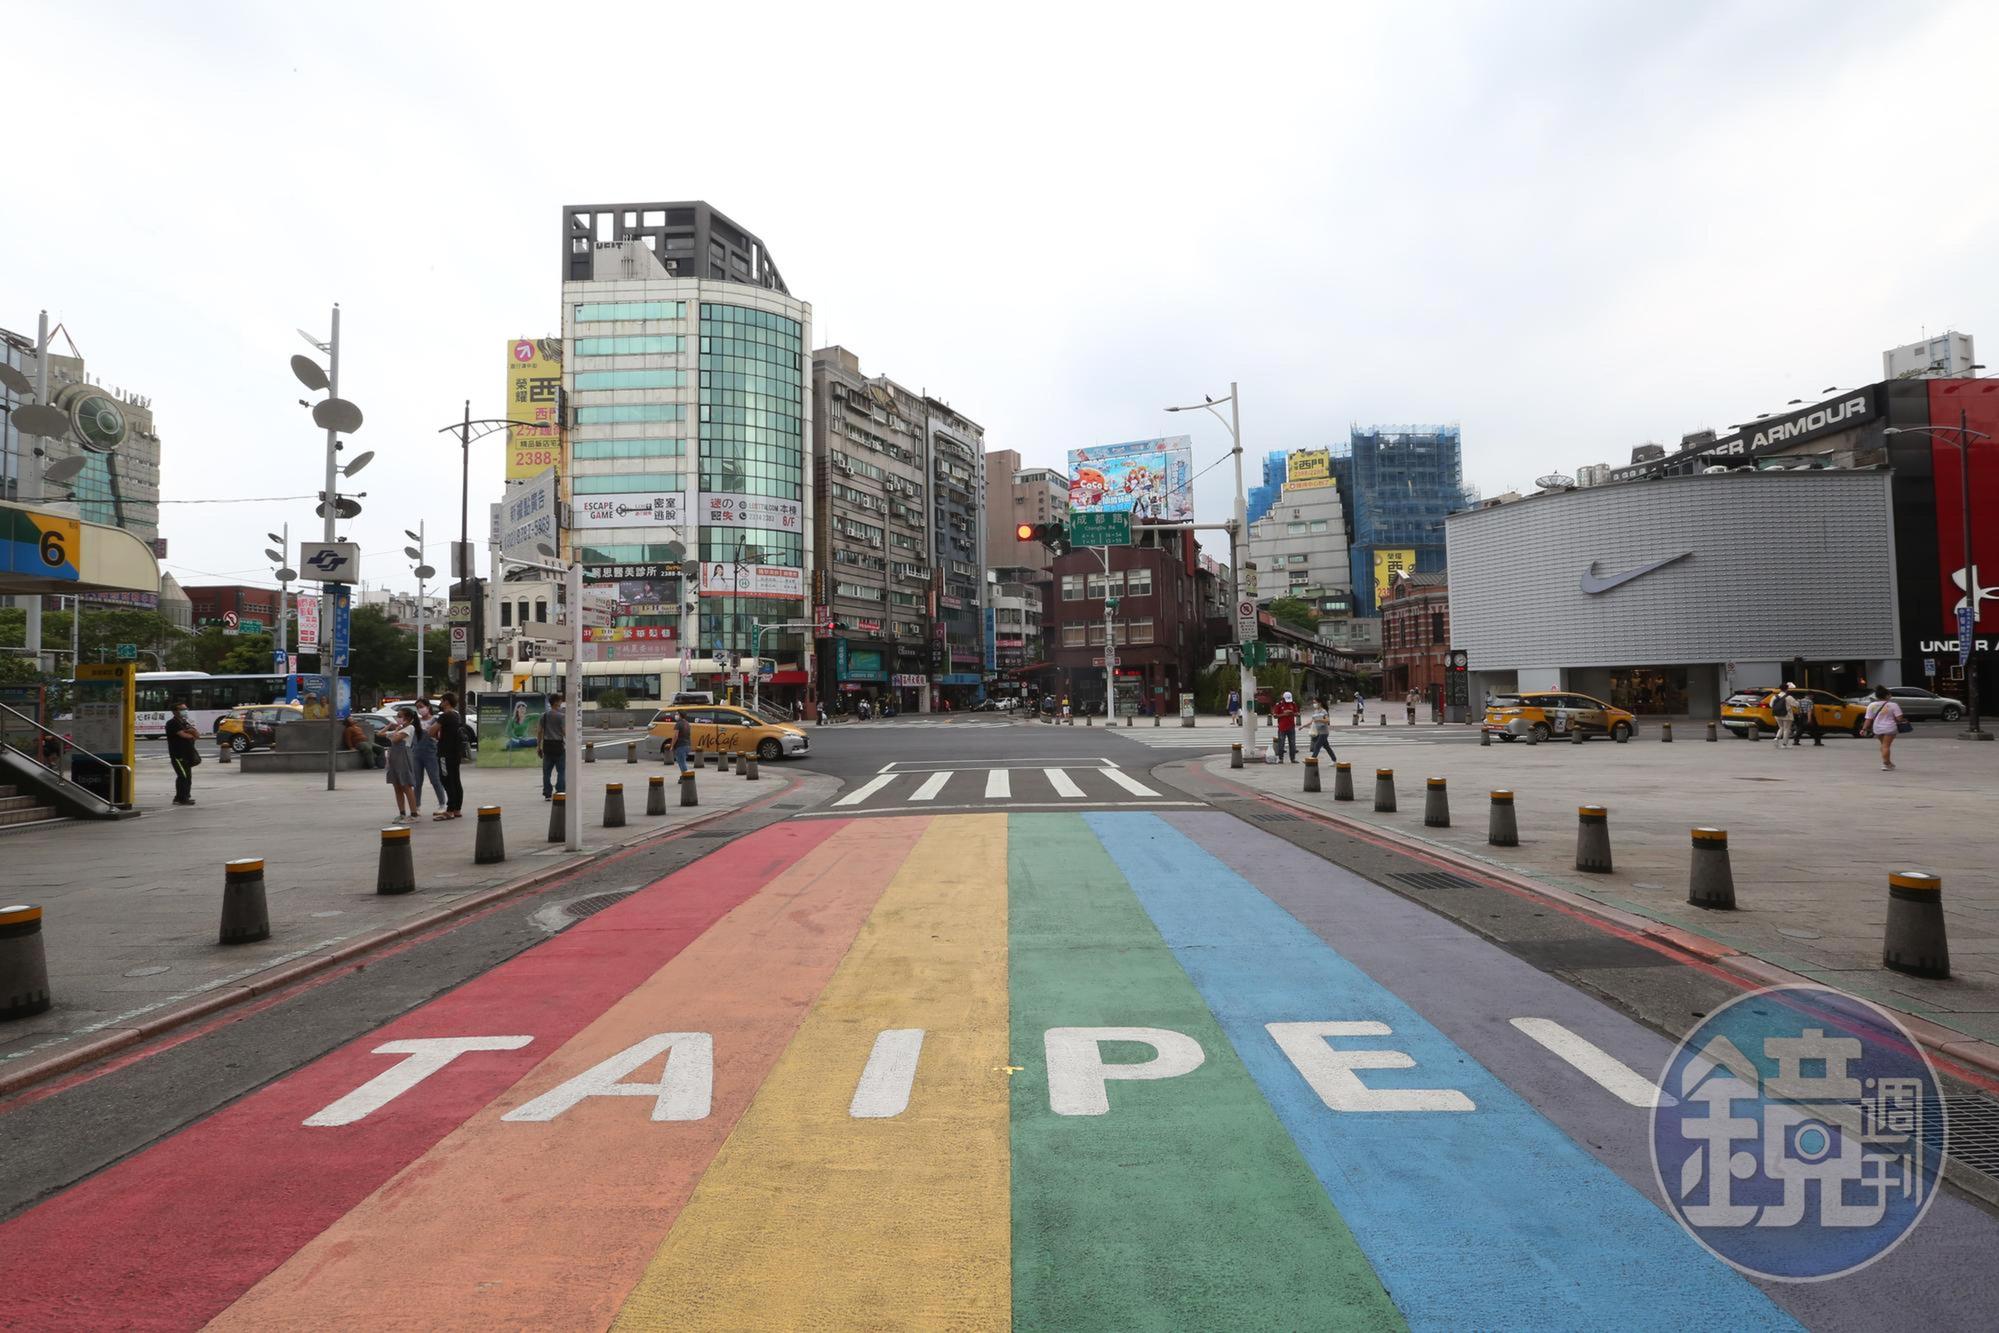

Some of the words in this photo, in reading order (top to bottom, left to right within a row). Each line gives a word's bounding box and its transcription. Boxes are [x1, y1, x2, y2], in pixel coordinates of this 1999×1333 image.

[1750, 397, 1867, 450] ARMOUR
[584, 502, 613, 510] ESCAPE
[654, 498, 676, 508] 密室
[590, 510, 613, 519] GAME
[654, 510, 676, 520] 逃脫
[40, 530, 66, 568] 6
[1920, 639, 1988, 652] UNDR
[699, 732, 739, 749] McCafé
